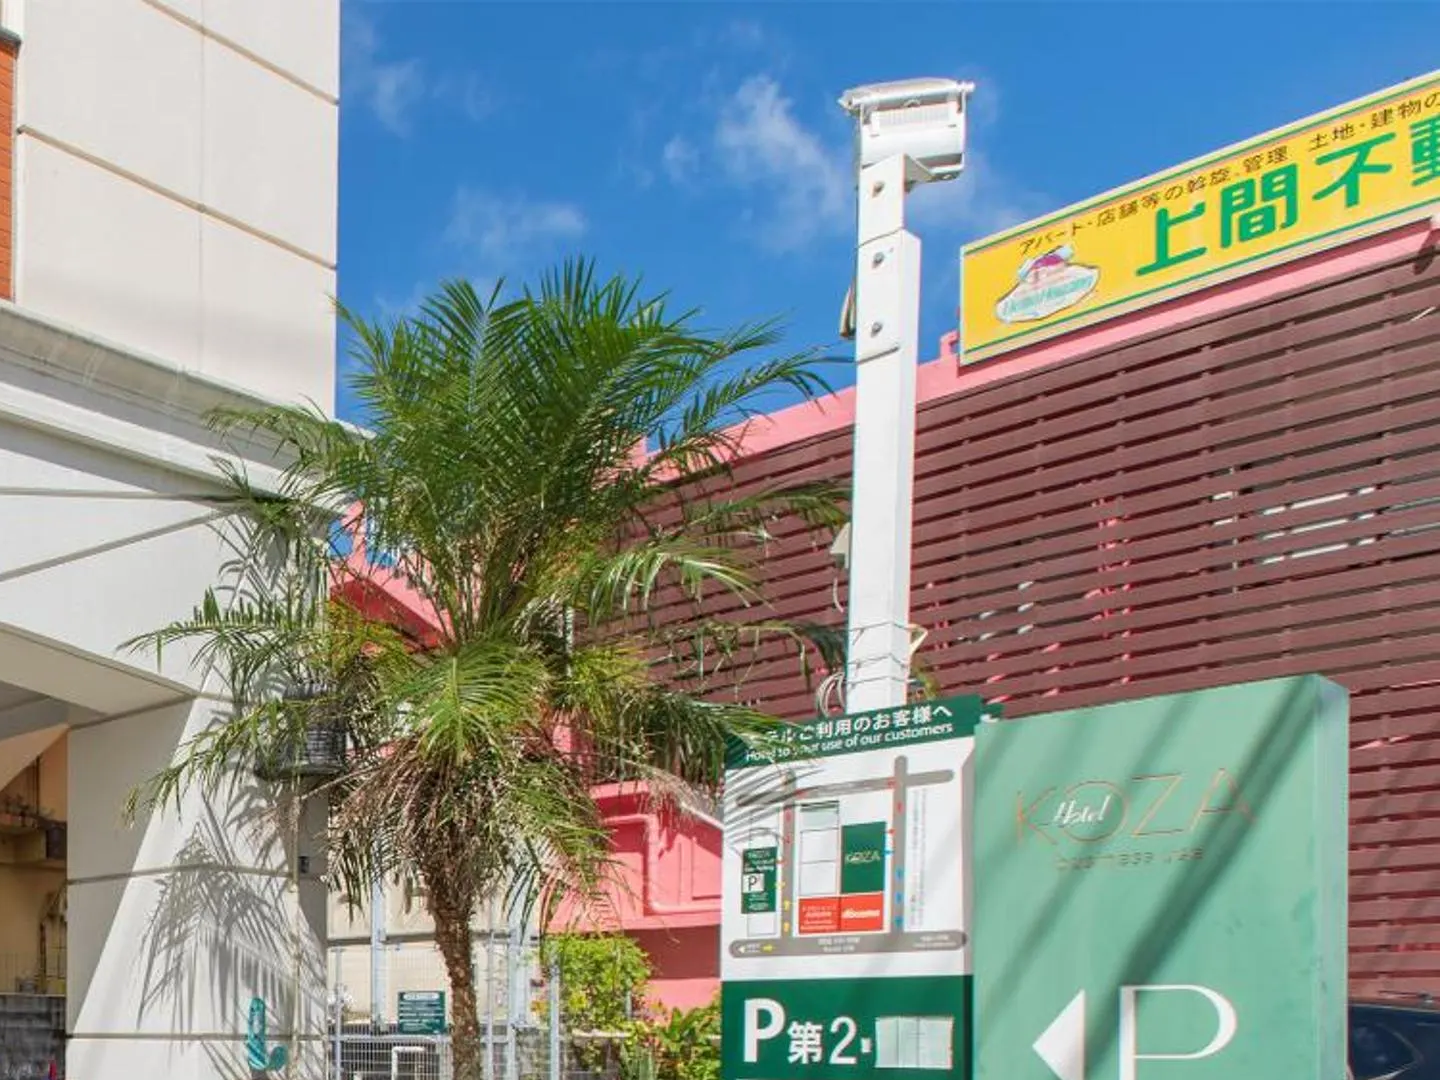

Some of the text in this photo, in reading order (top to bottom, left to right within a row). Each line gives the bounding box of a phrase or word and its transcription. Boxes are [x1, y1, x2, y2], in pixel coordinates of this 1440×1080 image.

[752, 704, 953, 746] テルご利用のお客様へ
[821, 740, 843, 752] use
[845, 733, 860, 747] of
[861, 731, 882, 746] our
[884, 722, 953, 742] customers
[1016, 768, 1256, 845] KOZA
[1052, 795, 1110, 827] Hotel
[743, 998, 786, 1063] P
